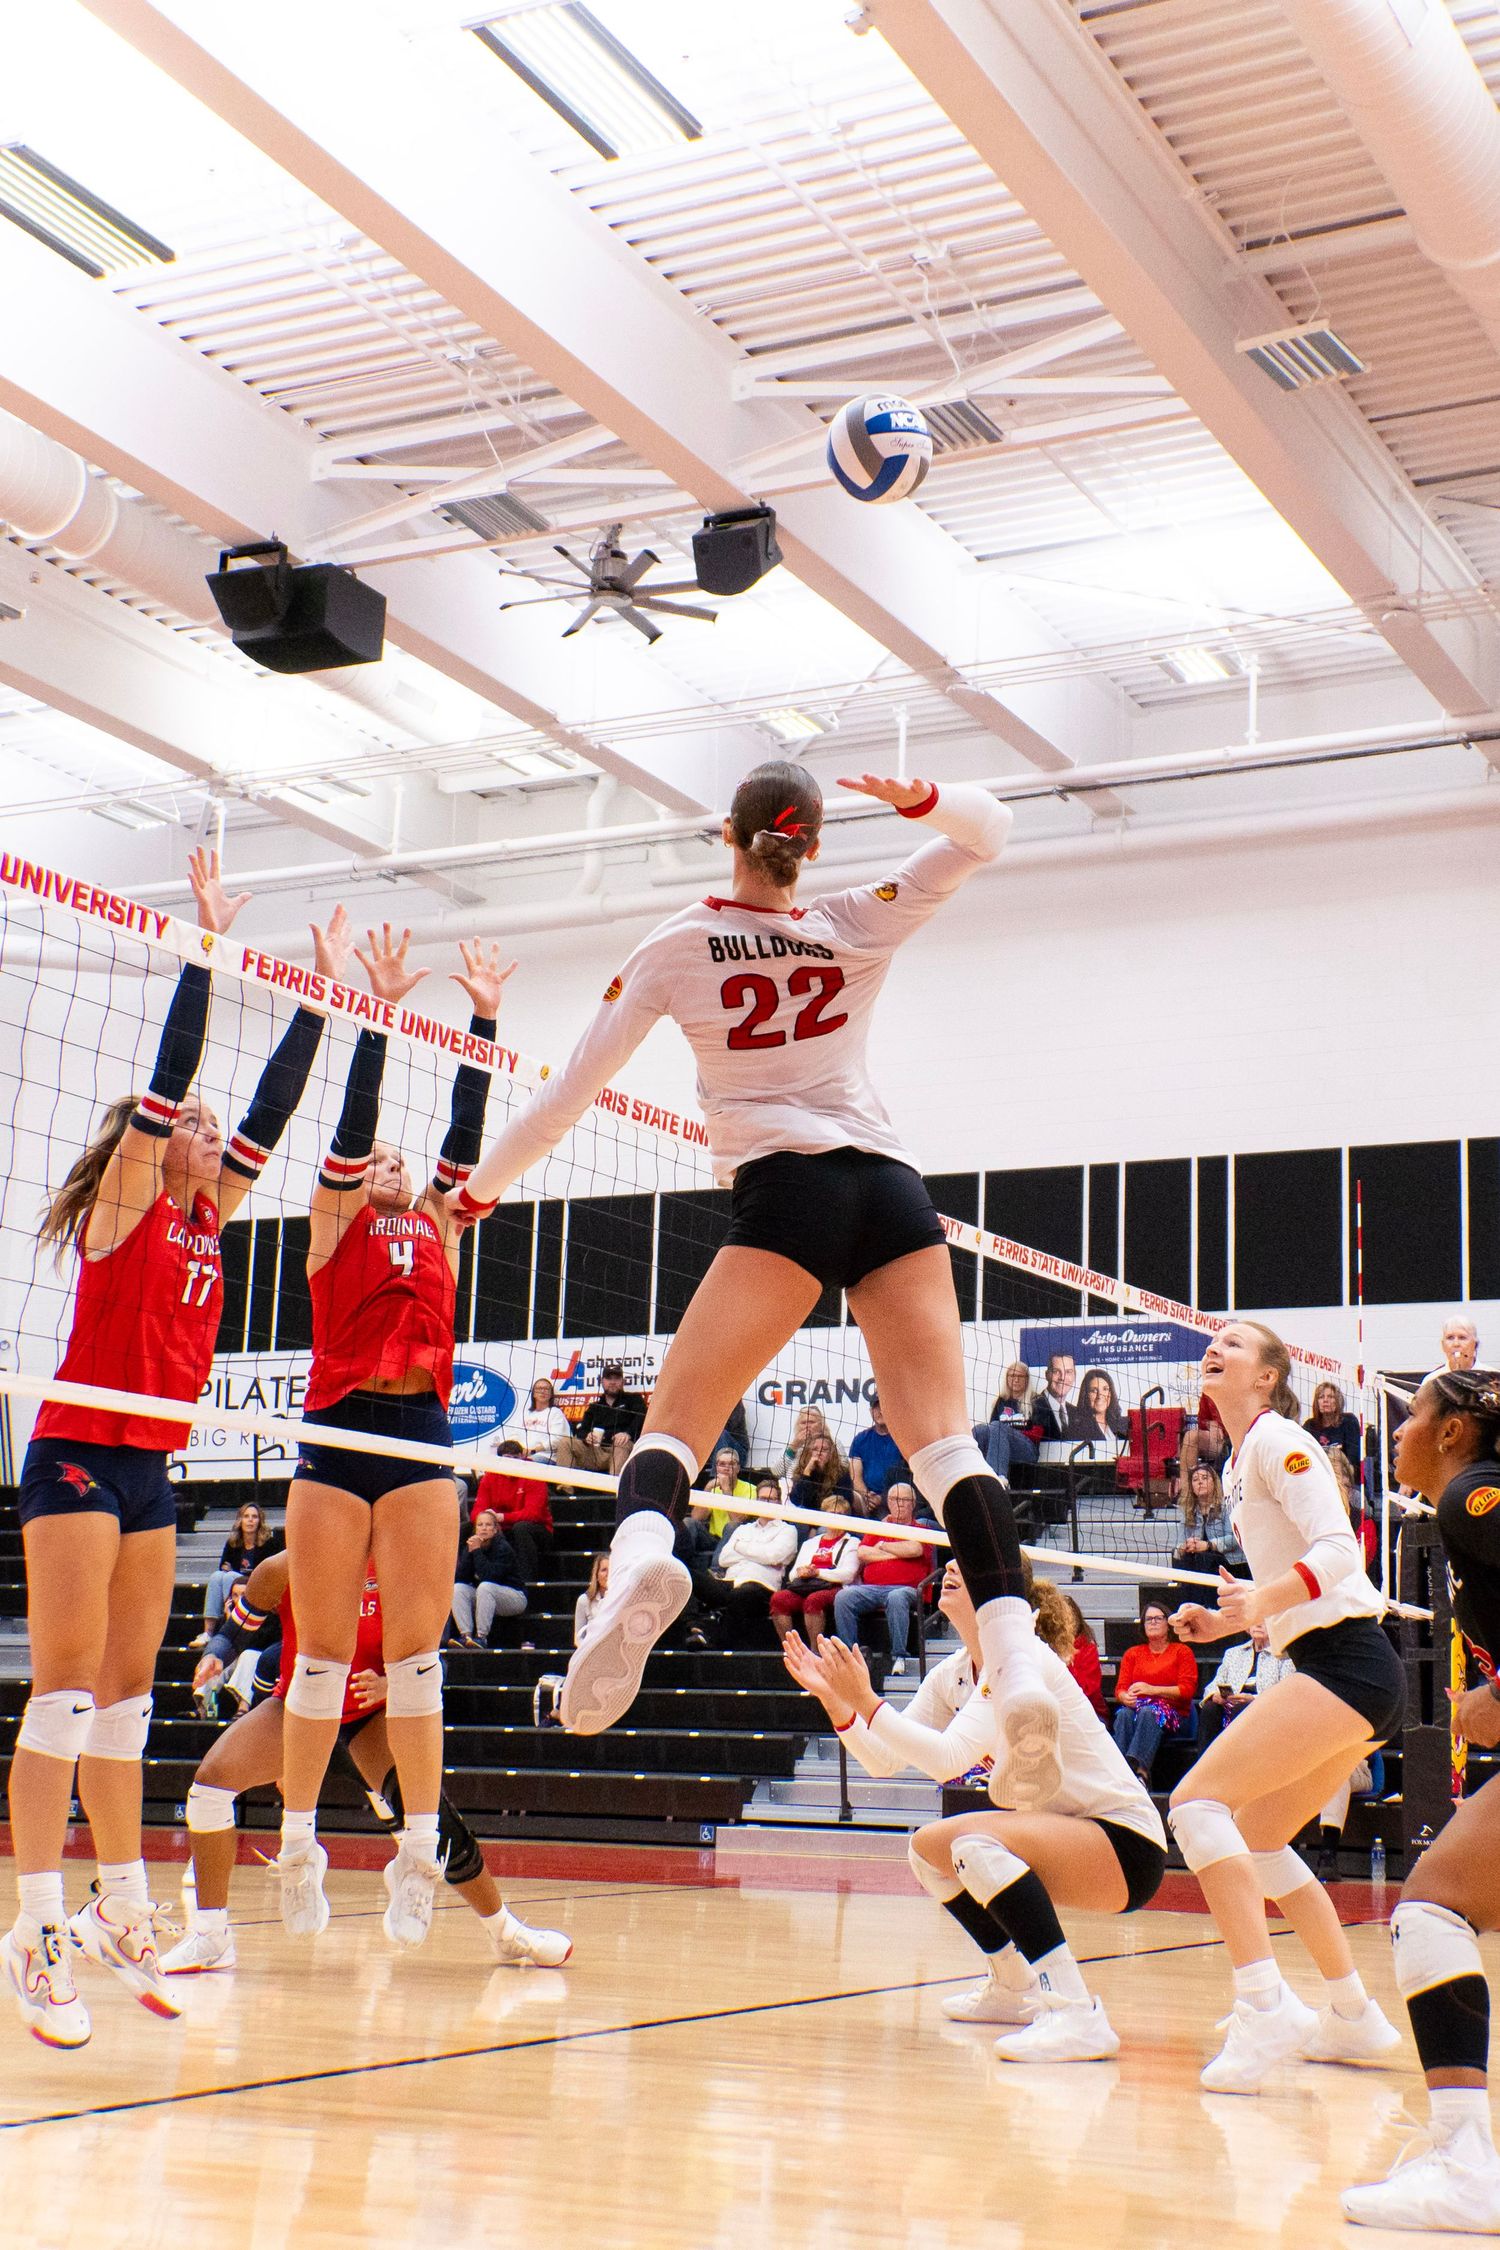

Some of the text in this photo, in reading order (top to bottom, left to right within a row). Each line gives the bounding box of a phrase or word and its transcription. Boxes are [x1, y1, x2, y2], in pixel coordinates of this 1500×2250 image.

[0, 852, 170, 940] UNIVERSITY
[241, 947, 520, 1074] FERRIS STATE UNIVERSITY
[720, 966, 849, 1051] 22
[632, 1099, 681, 1135] STATE
[388, 1240, 414, 1277] 4
[993, 1236, 1116, 1295] FERRIS STATE UNIVERSITY
[1139, 1290, 1169, 1316] FERRIS
[1170, 1302, 1193, 1323] STATE
[1081, 1329, 1172, 1345] Auto-Owners
[1099, 1344, 1154, 1354] INSURANCE
[1304, 1350, 1342, 1375] UNIVERSITY
[200, 1375, 307, 1410] PILATE
[553, 1396, 586, 1406] RUSTED
[190, 1428, 227, 1447] BIG
